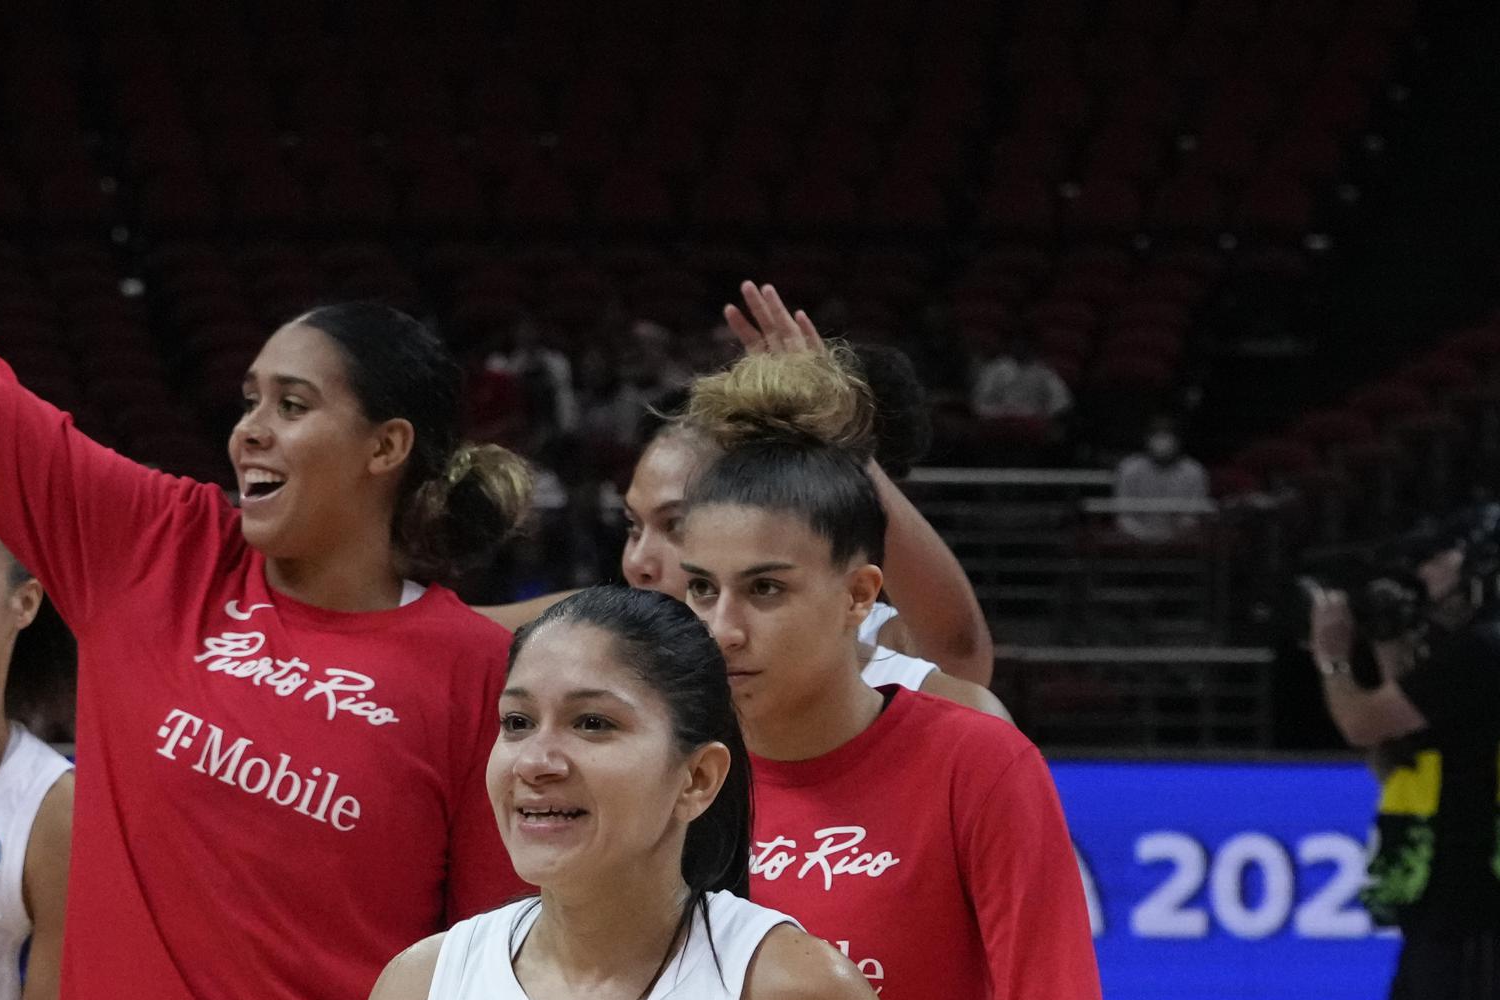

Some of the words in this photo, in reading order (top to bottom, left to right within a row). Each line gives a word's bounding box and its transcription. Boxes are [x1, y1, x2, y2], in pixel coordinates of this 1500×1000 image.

[193, 631, 310, 697] Puerto
[304, 667, 400, 726] Rico
[797, 825, 900, 891] Rico
